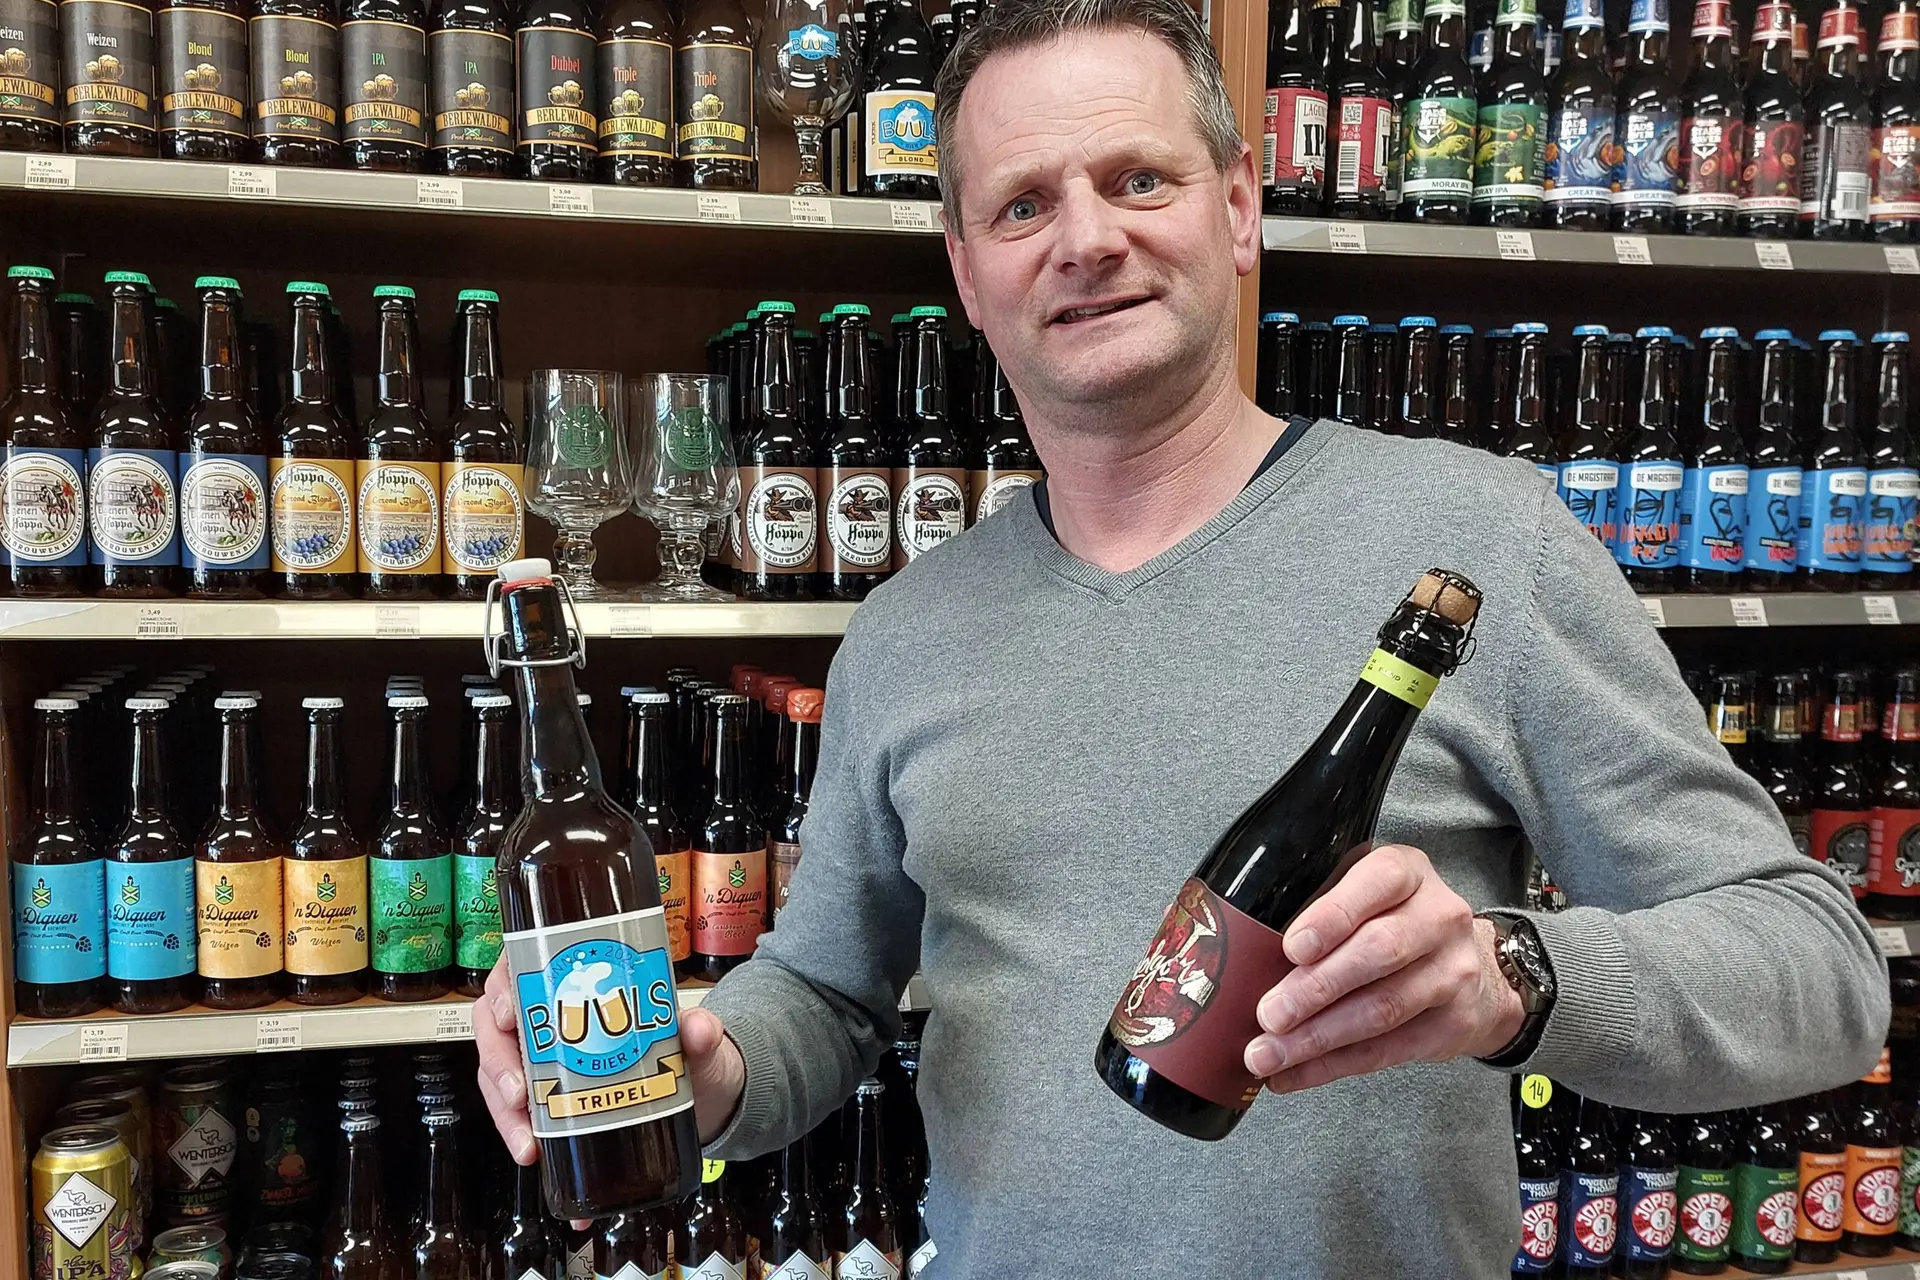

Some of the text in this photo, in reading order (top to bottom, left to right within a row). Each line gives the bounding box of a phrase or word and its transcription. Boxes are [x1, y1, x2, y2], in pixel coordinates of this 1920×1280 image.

[0, 26, 25, 41] eizen
[86, 32, 118, 48] Weizen
[188, 41, 213, 57] Blond
[285, 49, 310, 64] Blond
[371, 52, 386, 66] IPA
[464, 61, 478, 74] IPA
[551, 55, 580, 73] Dubbel
[613, 66, 637, 83] Triple
[693, 71, 717, 88] Triple
[0, 78, 46, 99] LEWALDE
[73, 84, 139, 105] BERLEWALDE
[171, 93, 235, 113] BERLEWALDE
[267, 101, 330, 120] BERLEWALDE
[1303, 103, 1327, 117] LAGUN
[350, 104, 413, 123] BERLEWALDE
[442, 112, 503, 130] BERLEWALDE
[536, 109, 593, 128] BERLEWALDE
[602, 120, 657, 134] BERLEWALDE
[683, 125, 737, 138] BERLEWALDE
[882, 119, 938, 140] BUULS
[1303, 124, 1325, 157] IP
[1473, 187, 1494, 196] ORAY
[285, 467, 325, 488] Hoppa
[377, 468, 417, 491] Hoppa
[462, 470, 501, 494] Hoppa
[1567, 473, 1576, 482] DE
[1636, 473, 1645, 482] DE
[765, 523, 804, 547] Hoppa
[848, 523, 884, 548] Hoppa
[915, 523, 951, 547] Hoppa
[703, 888, 715, 903] 'n
[292, 902, 303, 918] 'n
[383, 902, 394, 917] 'n
[460, 899, 470, 913] 'n
[209, 940, 240, 950] Weizen
[310, 937, 341, 948] Weizen
[525, 981, 674, 1053] BUULS
[591, 1052, 629, 1071] BIER
[577, 1085, 651, 1111] TRIPEL
[1528, 1079, 1545, 1103] 14
[178, 1144, 236, 1161] WENTERSC
[51, 1202, 107, 1218] WENTERSCH
[1682, 1192, 1730, 1220] JOPEN
[57, 1263, 106, 1280] IPA
